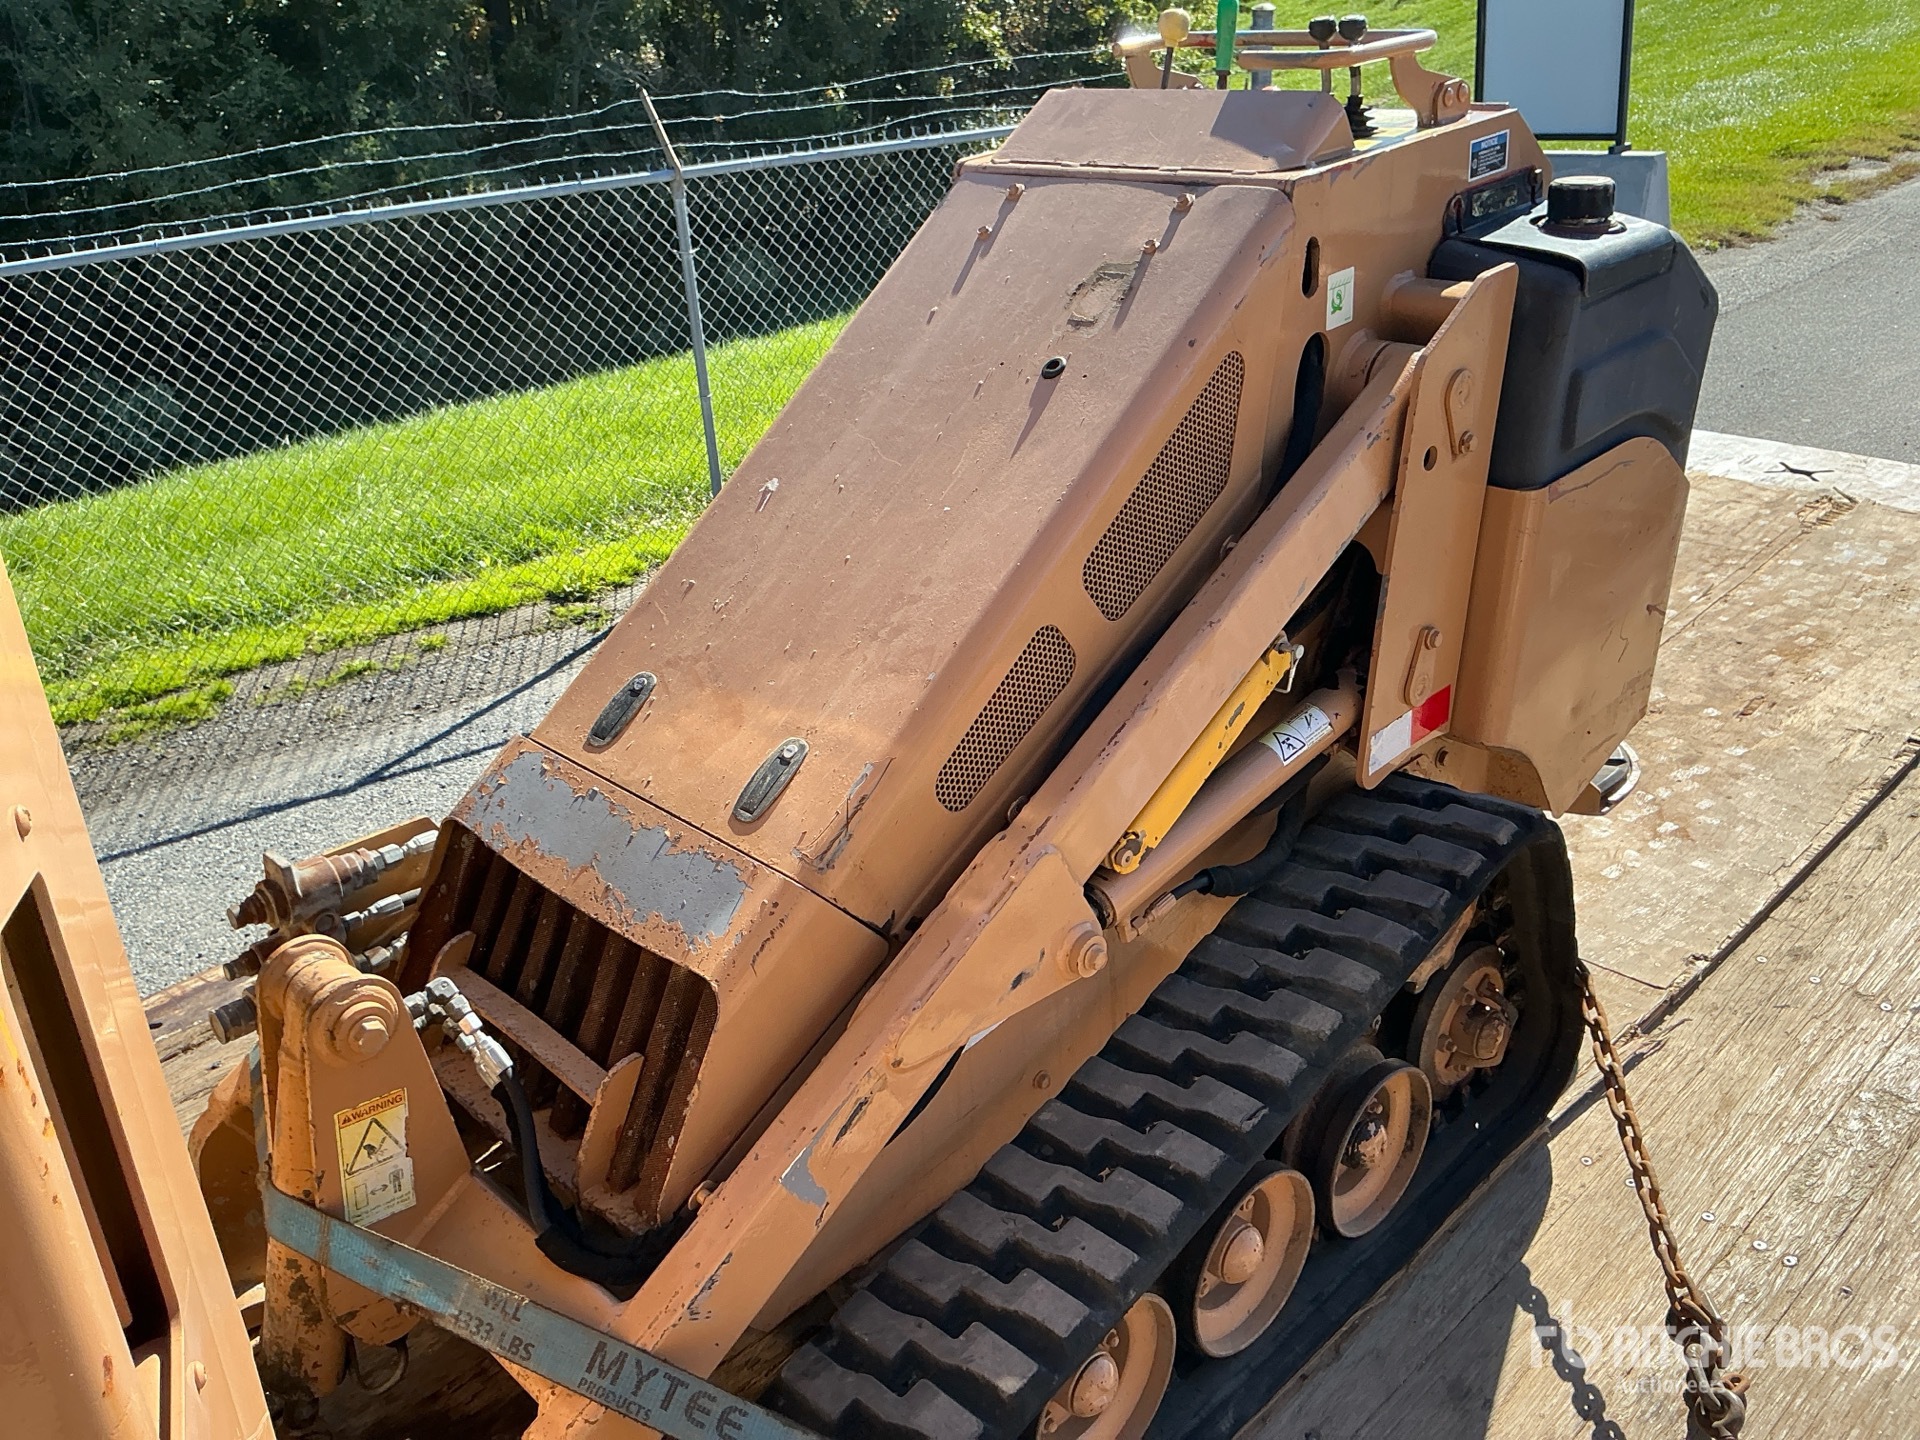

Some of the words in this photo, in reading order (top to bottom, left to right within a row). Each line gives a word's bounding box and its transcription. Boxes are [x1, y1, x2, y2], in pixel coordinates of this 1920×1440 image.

[350, 1094, 403, 1119] WARNING
[497, 1329, 535, 1361] LBS
[577, 1376, 652, 1421] PRODUCTS
[585, 1340, 750, 1440] MYTEE
